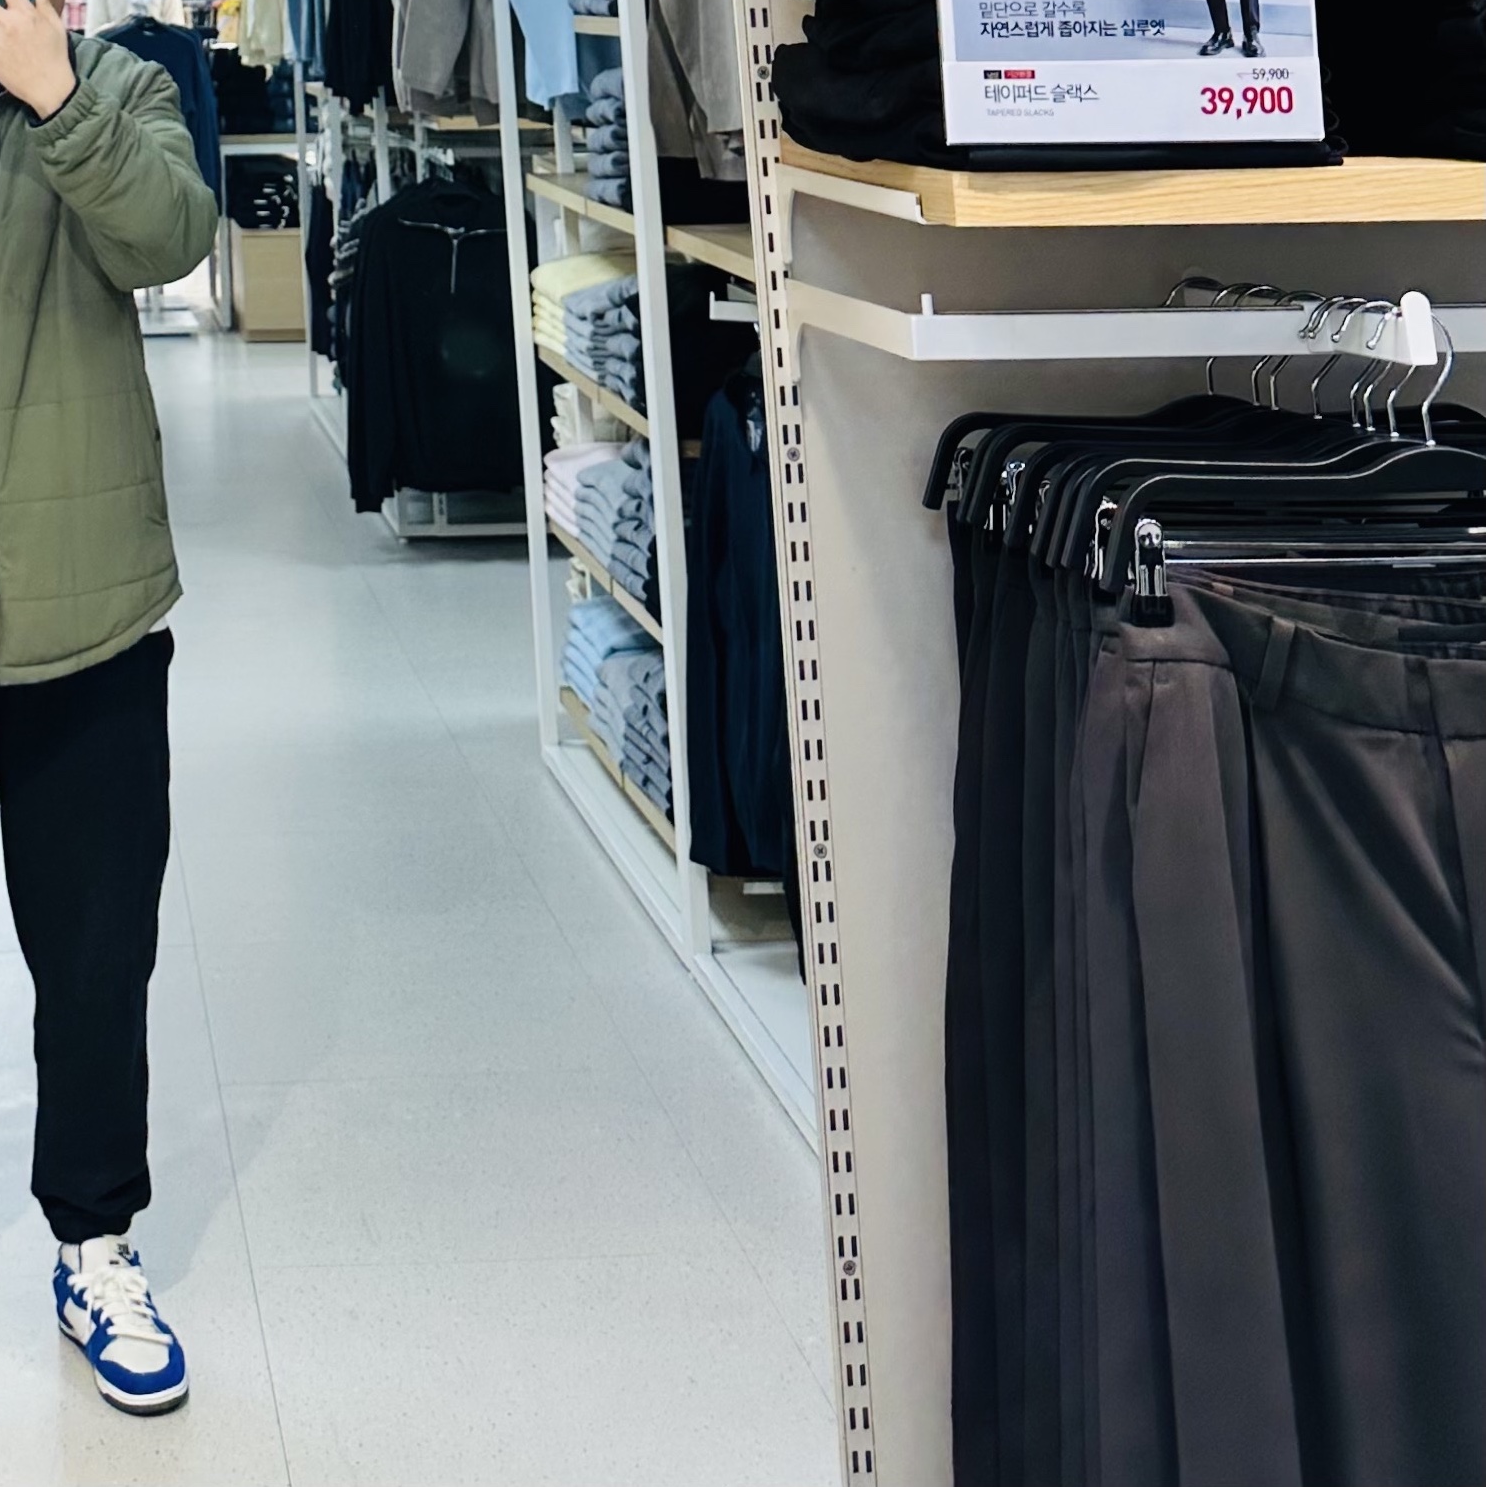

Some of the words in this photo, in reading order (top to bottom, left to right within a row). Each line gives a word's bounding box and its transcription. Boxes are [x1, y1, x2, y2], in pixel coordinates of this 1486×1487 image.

[979, 2, 1038, 19] 밑단으로
[1043, 1, 1086, 18] 갈수록
[980, 22, 1054, 38] 자연스럽게
[1059, 20, 1117, 37] 좁아지는
[1121, 19, 1165, 36] 실루엣
[1252, 69, 1290, 81] 59,900
[985, 85, 1049, 104] 테이퍼드
[1052, 83, 1099, 103] 슬랙스
[1200, 86, 1293, 120] 39,900
